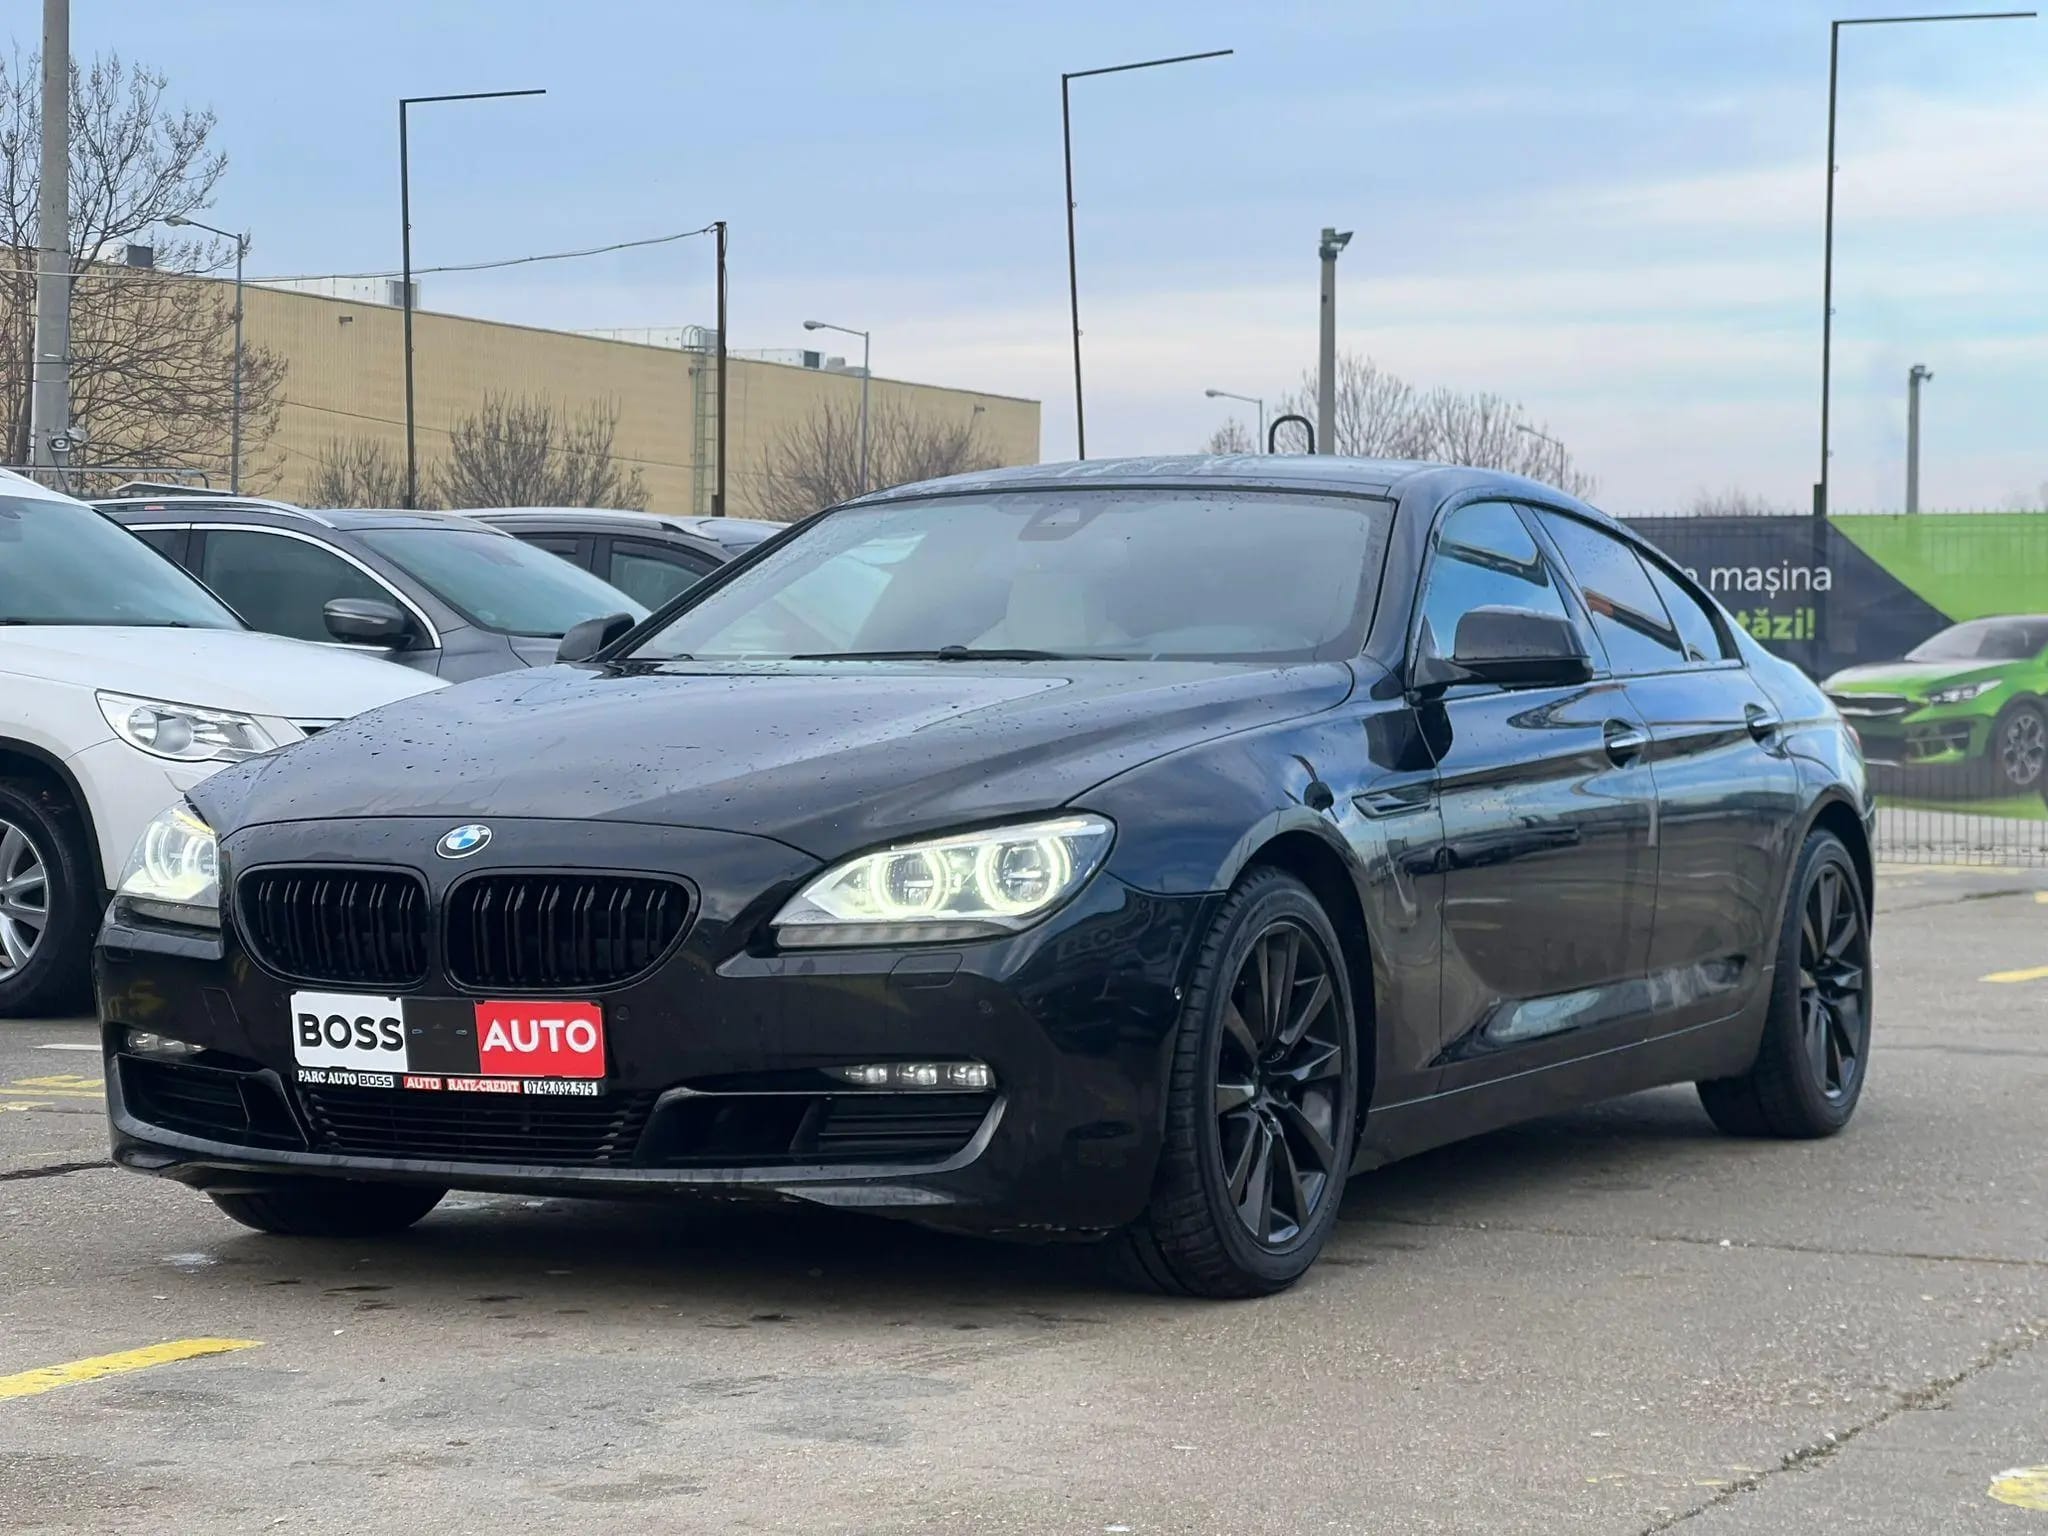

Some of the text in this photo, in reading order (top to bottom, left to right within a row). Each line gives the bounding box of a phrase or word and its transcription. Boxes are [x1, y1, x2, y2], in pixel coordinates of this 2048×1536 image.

[1710, 559, 1832, 599] mașina
[298, 1013, 597, 1053] BOSS AUTO
[298, 1070, 326, 1083] PARC
[327, 1072, 357, 1085] AUTO
[360, 1075, 392, 1087] BOSS
[406, 1077, 441, 1090] AUTO
